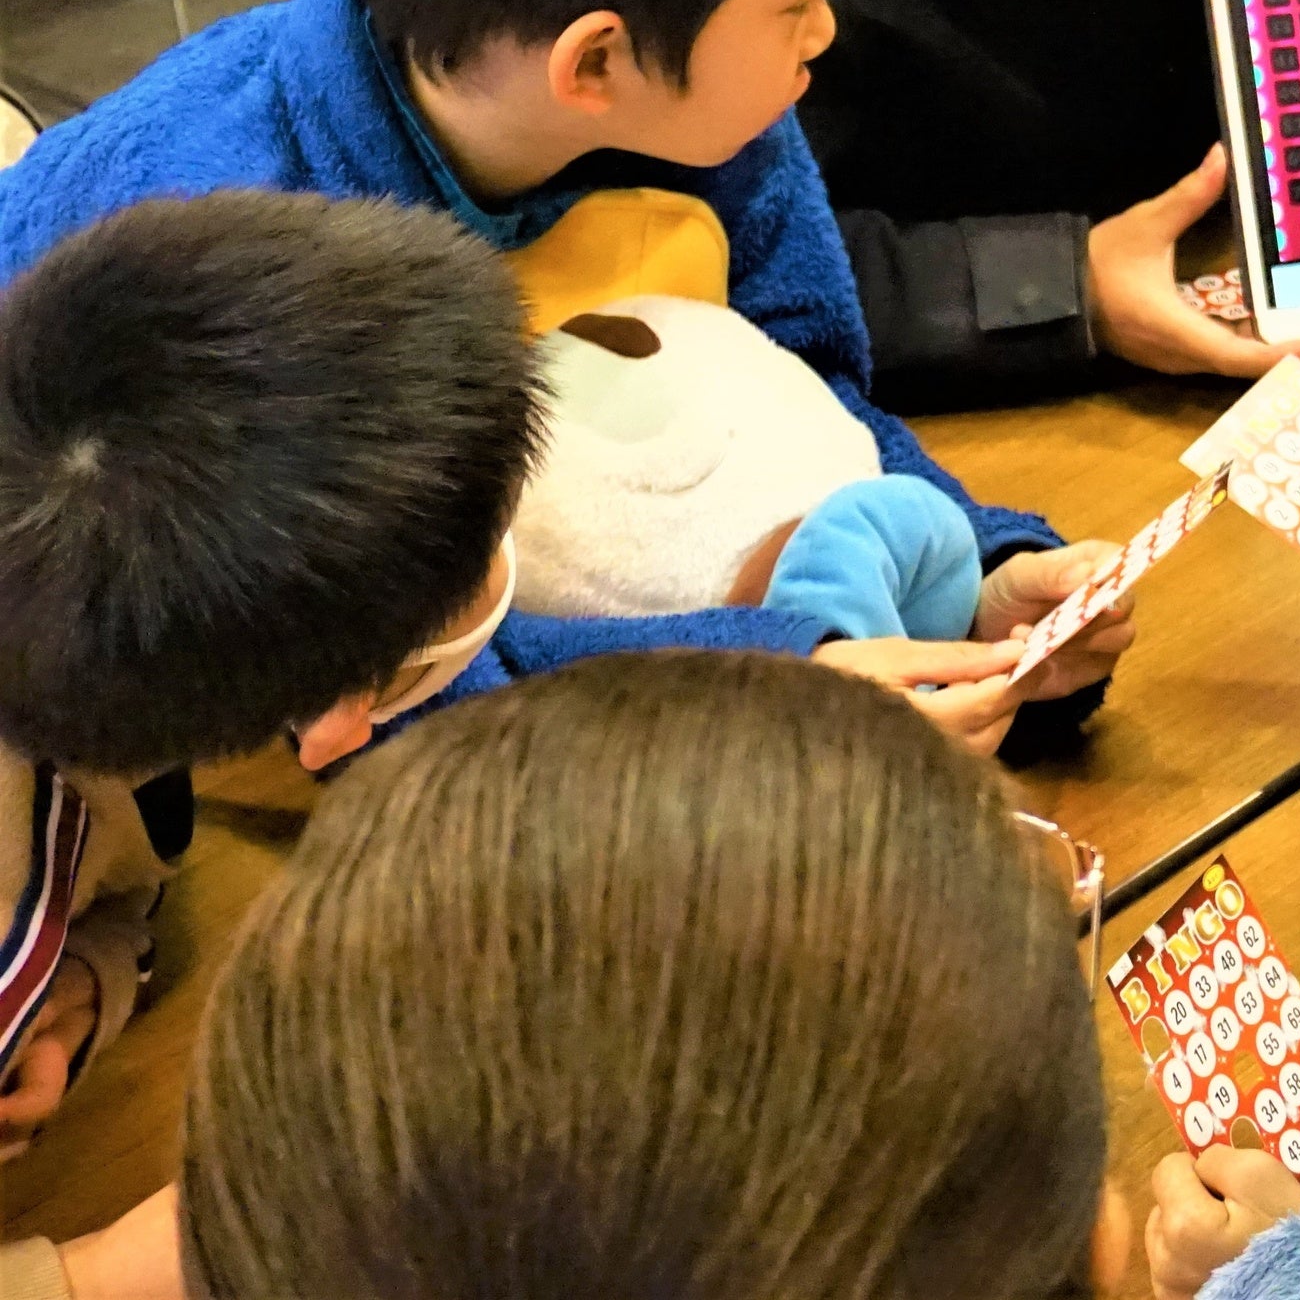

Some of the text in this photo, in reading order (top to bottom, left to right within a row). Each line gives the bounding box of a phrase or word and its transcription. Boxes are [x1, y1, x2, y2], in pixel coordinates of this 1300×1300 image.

[1274, 509, 1288, 521] 2
[1120, 879, 1245, 1025] BINGO
[1170, 925, 1260, 1026] 20 33 48 62
[1172, 966, 1281, 1090] 4 17 31 53 64
[1192, 1115, 1204, 1133] 1
[1214, 1086, 1231, 1108] 19
[1262, 1032, 1280, 1056] 55
[1261, 1099, 1279, 1123] 34
